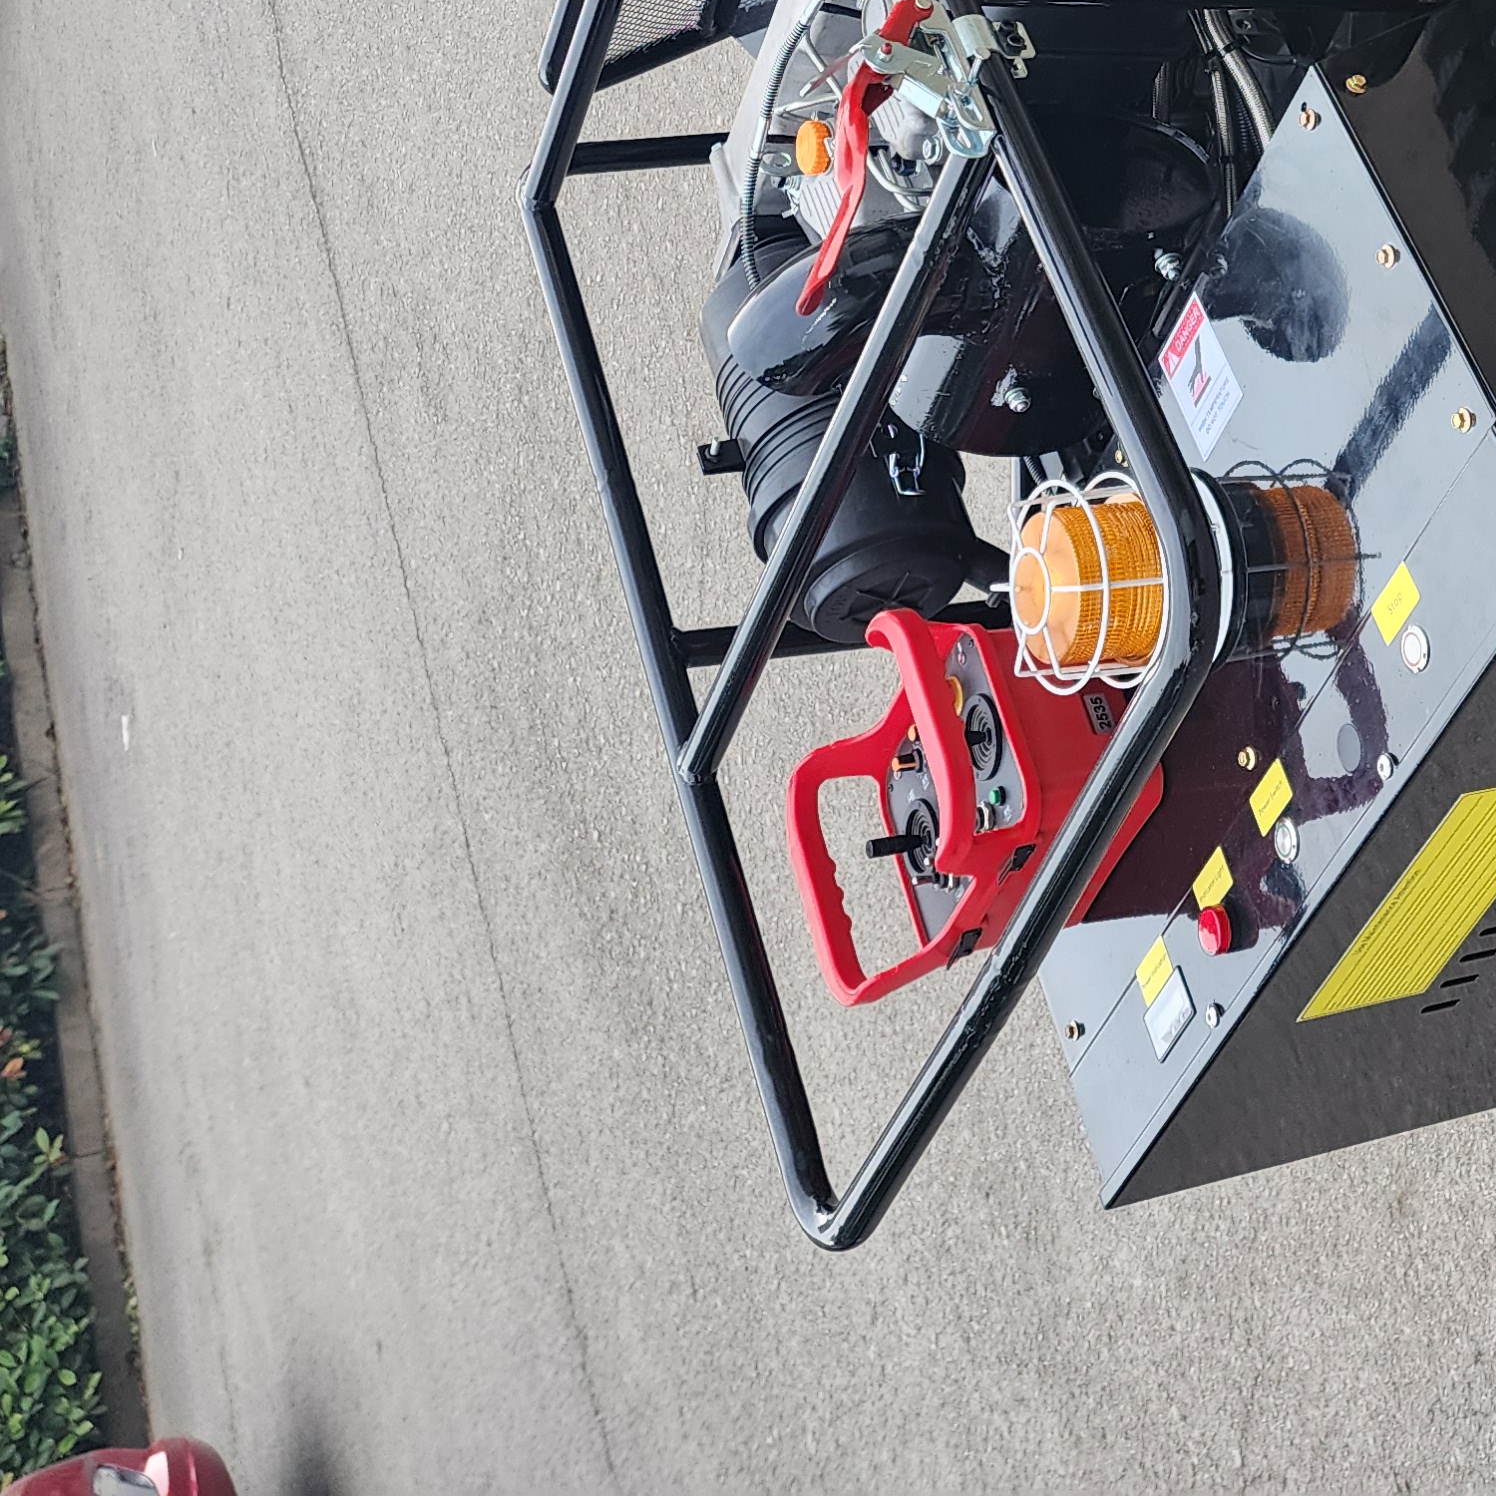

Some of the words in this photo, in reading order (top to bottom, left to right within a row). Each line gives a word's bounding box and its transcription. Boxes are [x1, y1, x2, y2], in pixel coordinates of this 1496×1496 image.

[1174, 307, 1201, 352] DANGER
[1386, 592, 1403, 616] Stop
[1090, 696, 1111, 730] 2535
[1214, 864, 1225, 881] Light
